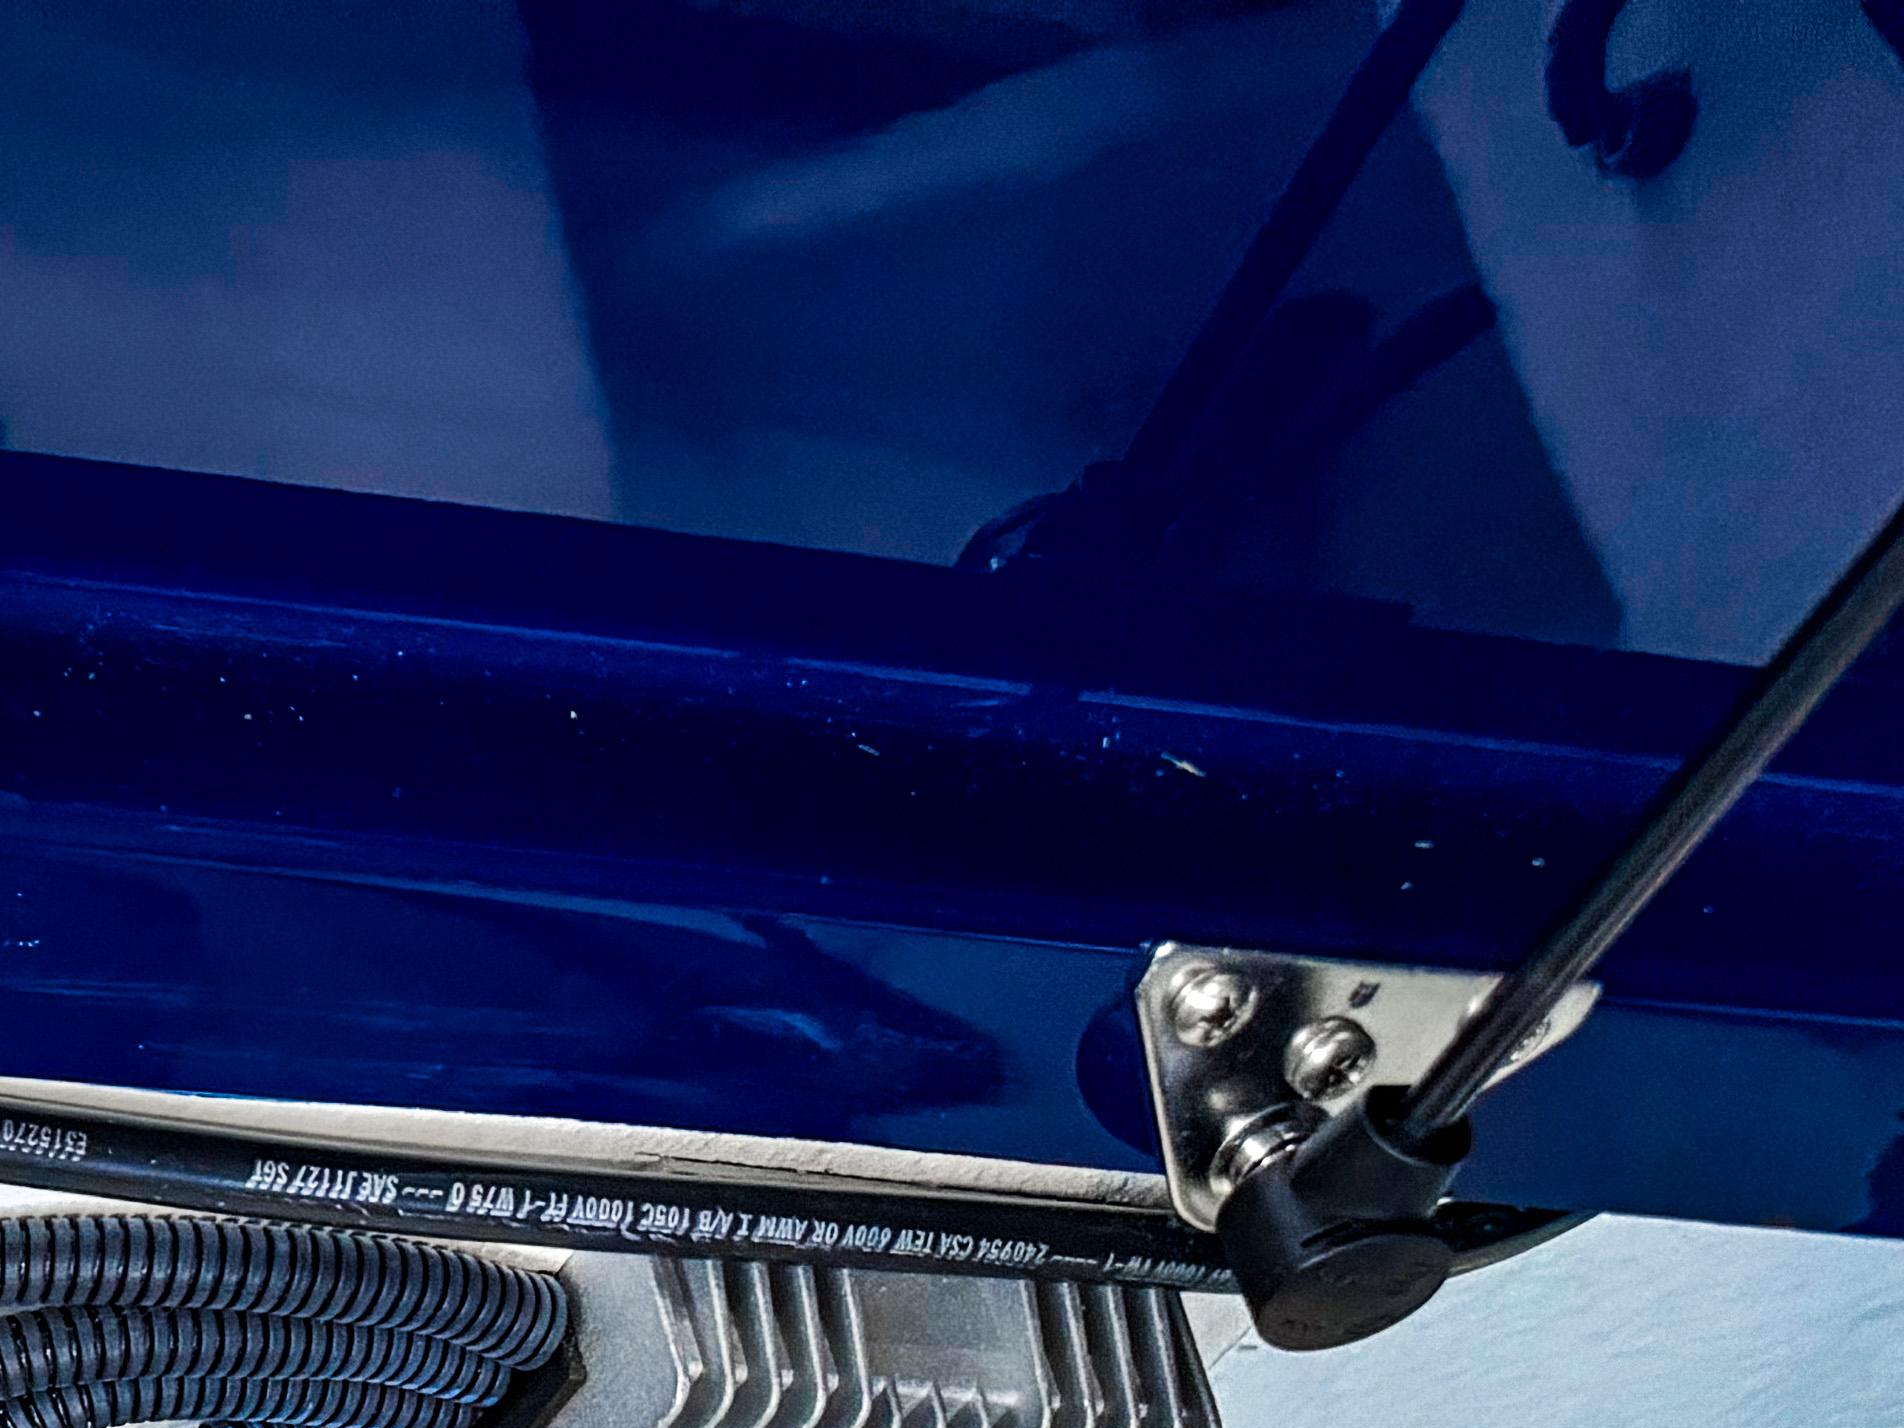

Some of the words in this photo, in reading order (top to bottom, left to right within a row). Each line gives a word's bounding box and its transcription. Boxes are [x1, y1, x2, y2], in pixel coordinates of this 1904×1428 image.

[248, 1158, 290, 1188] SGT
[360, 1168, 400, 1202] SAE
[638, 1202, 691, 1233] 105C
[756, 1214, 810, 1241] AWM
[812, 1218, 839, 1244] OR
[842, 1224, 892, 1250] 600V
[893, 1228, 935, 1253] TEW
